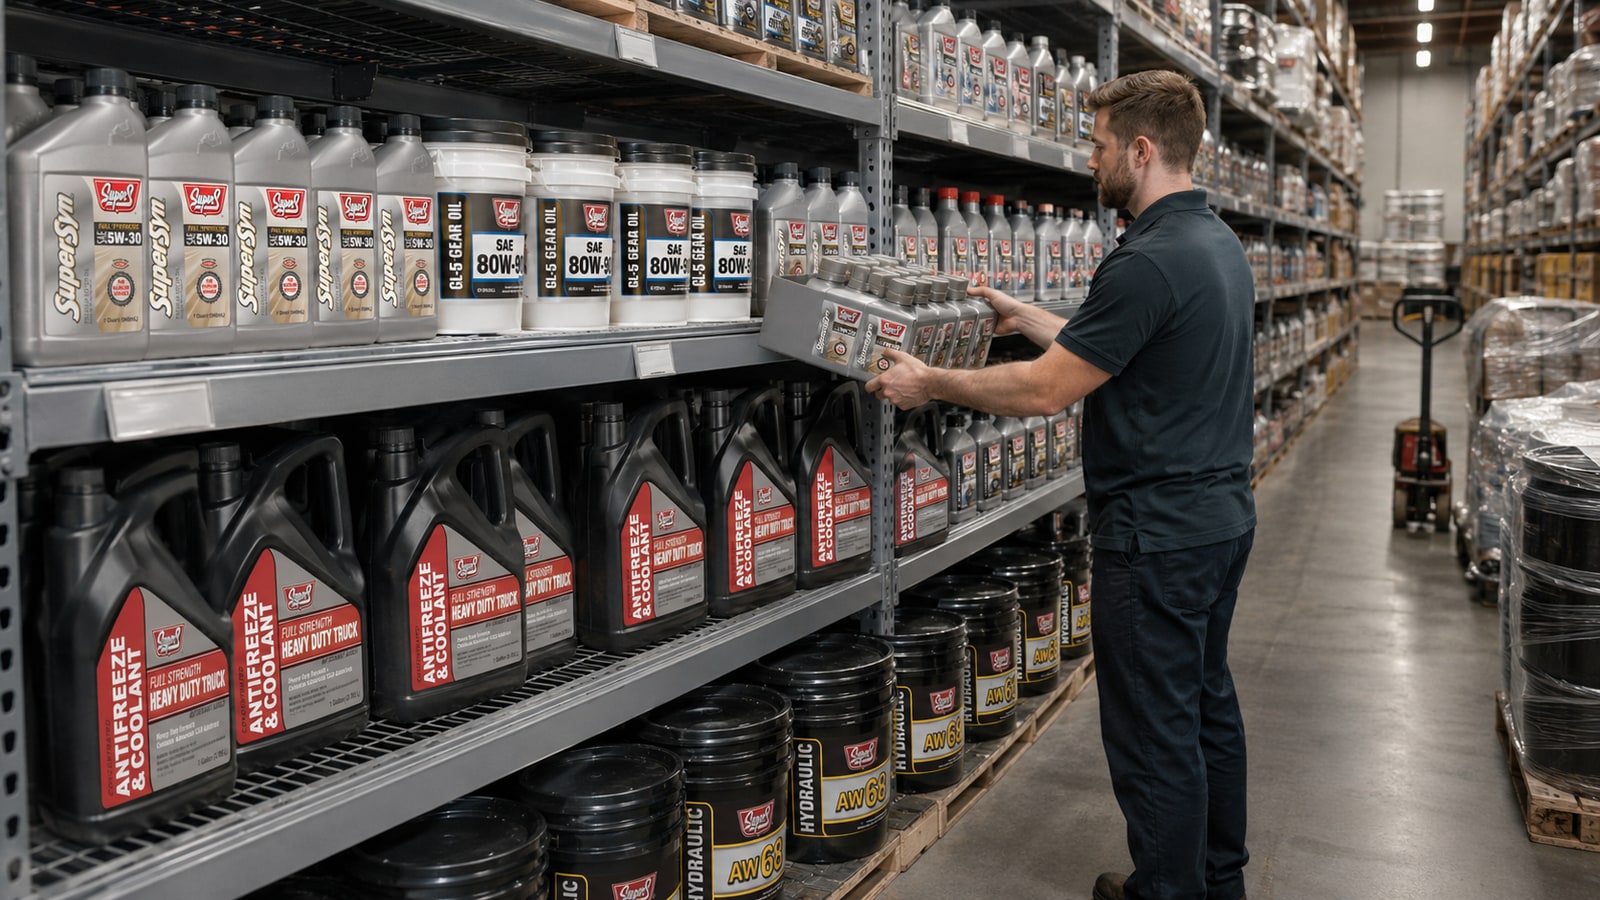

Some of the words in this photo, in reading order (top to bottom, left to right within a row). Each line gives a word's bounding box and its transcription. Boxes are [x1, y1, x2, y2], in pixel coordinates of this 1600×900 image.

[448, 201, 462, 220] OIL
[545, 207, 556, 223] OIL
[628, 211, 638, 227] OIL
[692, 214, 705, 230] OIL
[107, 231, 142, 244] 5W-30
[196, 232, 229, 245] 5W-30
[278, 235, 307, 247] 5W-30
[449, 224, 463, 258] GEAR
[496, 239, 514, 251] SAE
[545, 228, 557, 259] GEAR
[587, 242, 603, 253] SAE
[667, 244, 682, 255] SAE
[733, 245, 747, 255] SAE
[53, 191, 81, 324] SuperSyn
[150, 197, 173, 319] SuperSyn
[236, 201, 258, 315] SuperSyn
[316, 205, 334, 311] SuperSyn
[381, 209, 398, 308] SuperSyn
[449, 263, 463, 290] GL-5
[545, 263, 557, 289] GL-5
[628, 264, 639, 288] GL-5
[692, 263, 706, 287] GL-5
[825, 479, 833, 548] COOLANT
[734, 489, 744, 587] ANTIFREEZE
[743, 498, 752, 572] COOLANT
[629, 513, 642, 619] ANTIFREEZE
[640, 522, 651, 603] COOLANT
[432, 571, 447, 664] COOLANT
[451, 602, 476, 622] HEAVY
[476, 596, 495, 615] DUTY
[496, 590, 518, 610] TRUCK
[642, 603, 651, 616] &
[282, 625, 298, 639] FULL
[418, 562, 436, 683] ANTIFREEZE
[282, 634, 309, 659] HEAVY
[311, 628, 332, 651] DUTY
[333, 620, 358, 643] TRUCK
[243, 592, 264, 734] ANTIFREEZE
[259, 602, 278, 710] COOLANT
[150, 675, 166, 689] FULL
[167, 662, 202, 684] STRENGTH
[436, 664, 448, 680] &
[150, 683, 179, 712] HEAVY
[179, 677, 201, 703] DUTY
[201, 669, 226, 694] TRUCK
[110, 636, 130, 797] ANTIFREEZE
[127, 647, 145, 769] COOLANT
[265, 711, 278, 729] &
[132, 771, 146, 791] &
[797, 743, 815, 833] HYDRAULIC
